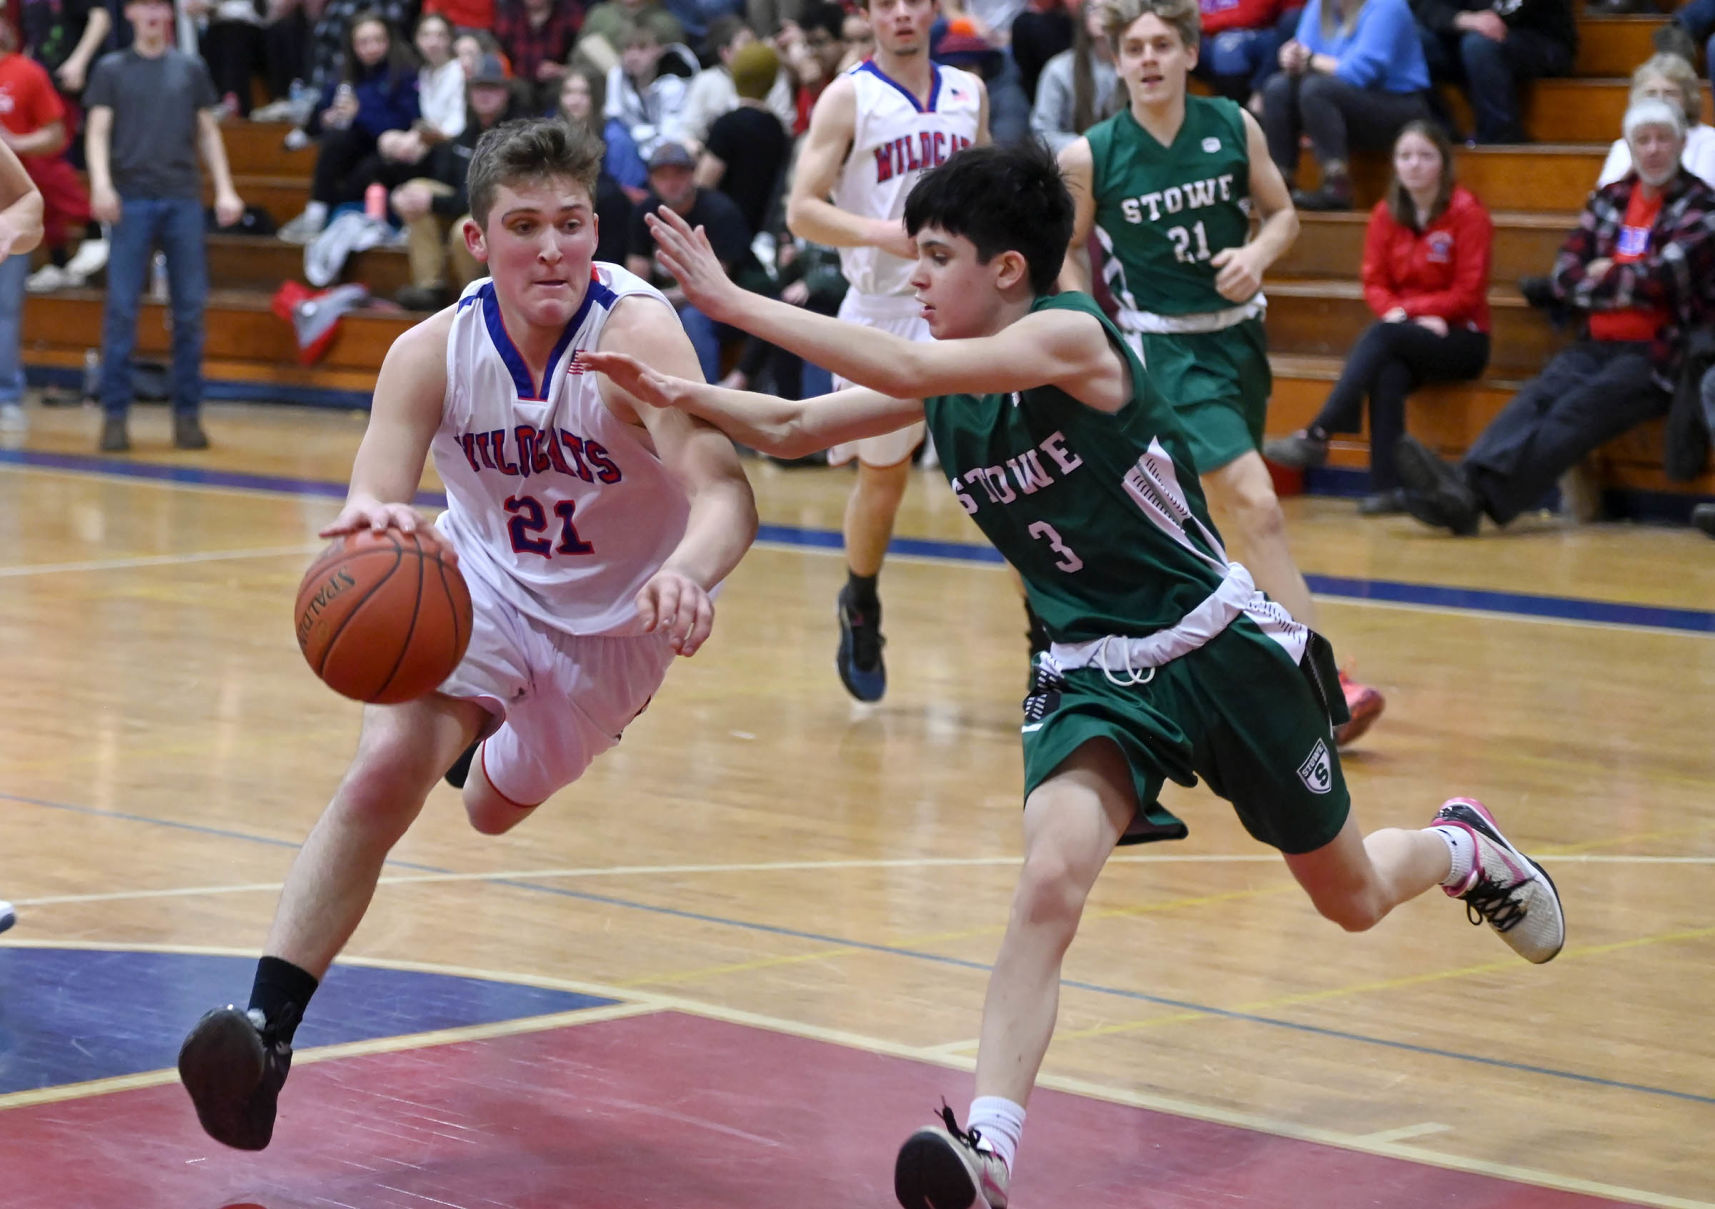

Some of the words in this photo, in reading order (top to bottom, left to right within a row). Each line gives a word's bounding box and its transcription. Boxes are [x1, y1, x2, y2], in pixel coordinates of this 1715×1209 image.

[1167, 220, 1211, 264] 21
[951, 430, 1084, 515] STOWE
[503, 494, 595, 560] 21
[1028, 520, 1084, 573] 3
[1315, 762, 1329, 787] S
